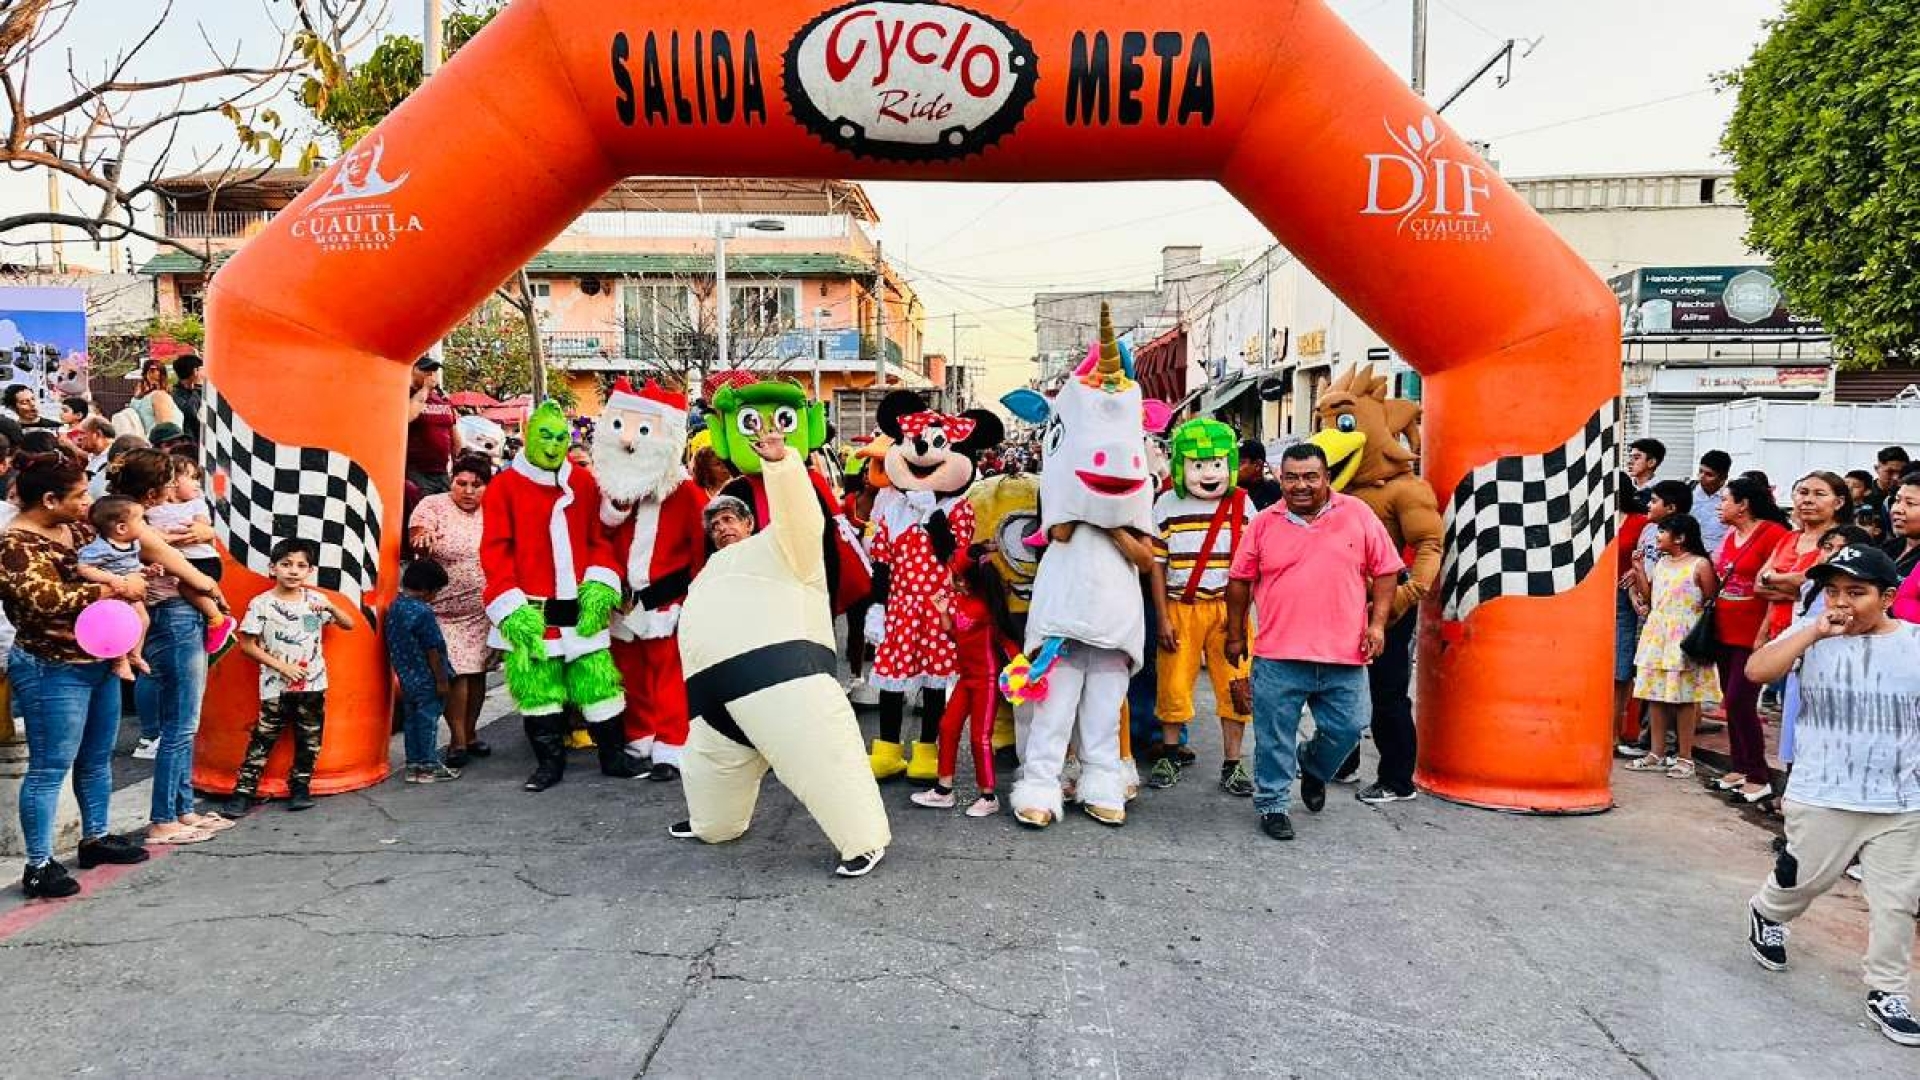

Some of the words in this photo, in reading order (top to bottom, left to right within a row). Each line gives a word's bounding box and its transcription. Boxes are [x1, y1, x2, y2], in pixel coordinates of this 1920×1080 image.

[826, 10, 1000, 98] Cyclo
[611, 29, 767, 126] SALIDA
[1065, 30, 1215, 126] META
[876, 89, 953, 124] Ride
[1359, 153, 1492, 217] DIF
[291, 212, 424, 238] CUAUTLA
[316, 231, 396, 243] MORELOS
[1410, 218, 1492, 235] CUAUTLA
[1660, 287, 1678, 295] Hot
[1680, 287, 1706, 297] dogs
[1676, 300, 1716, 308] Nachos
